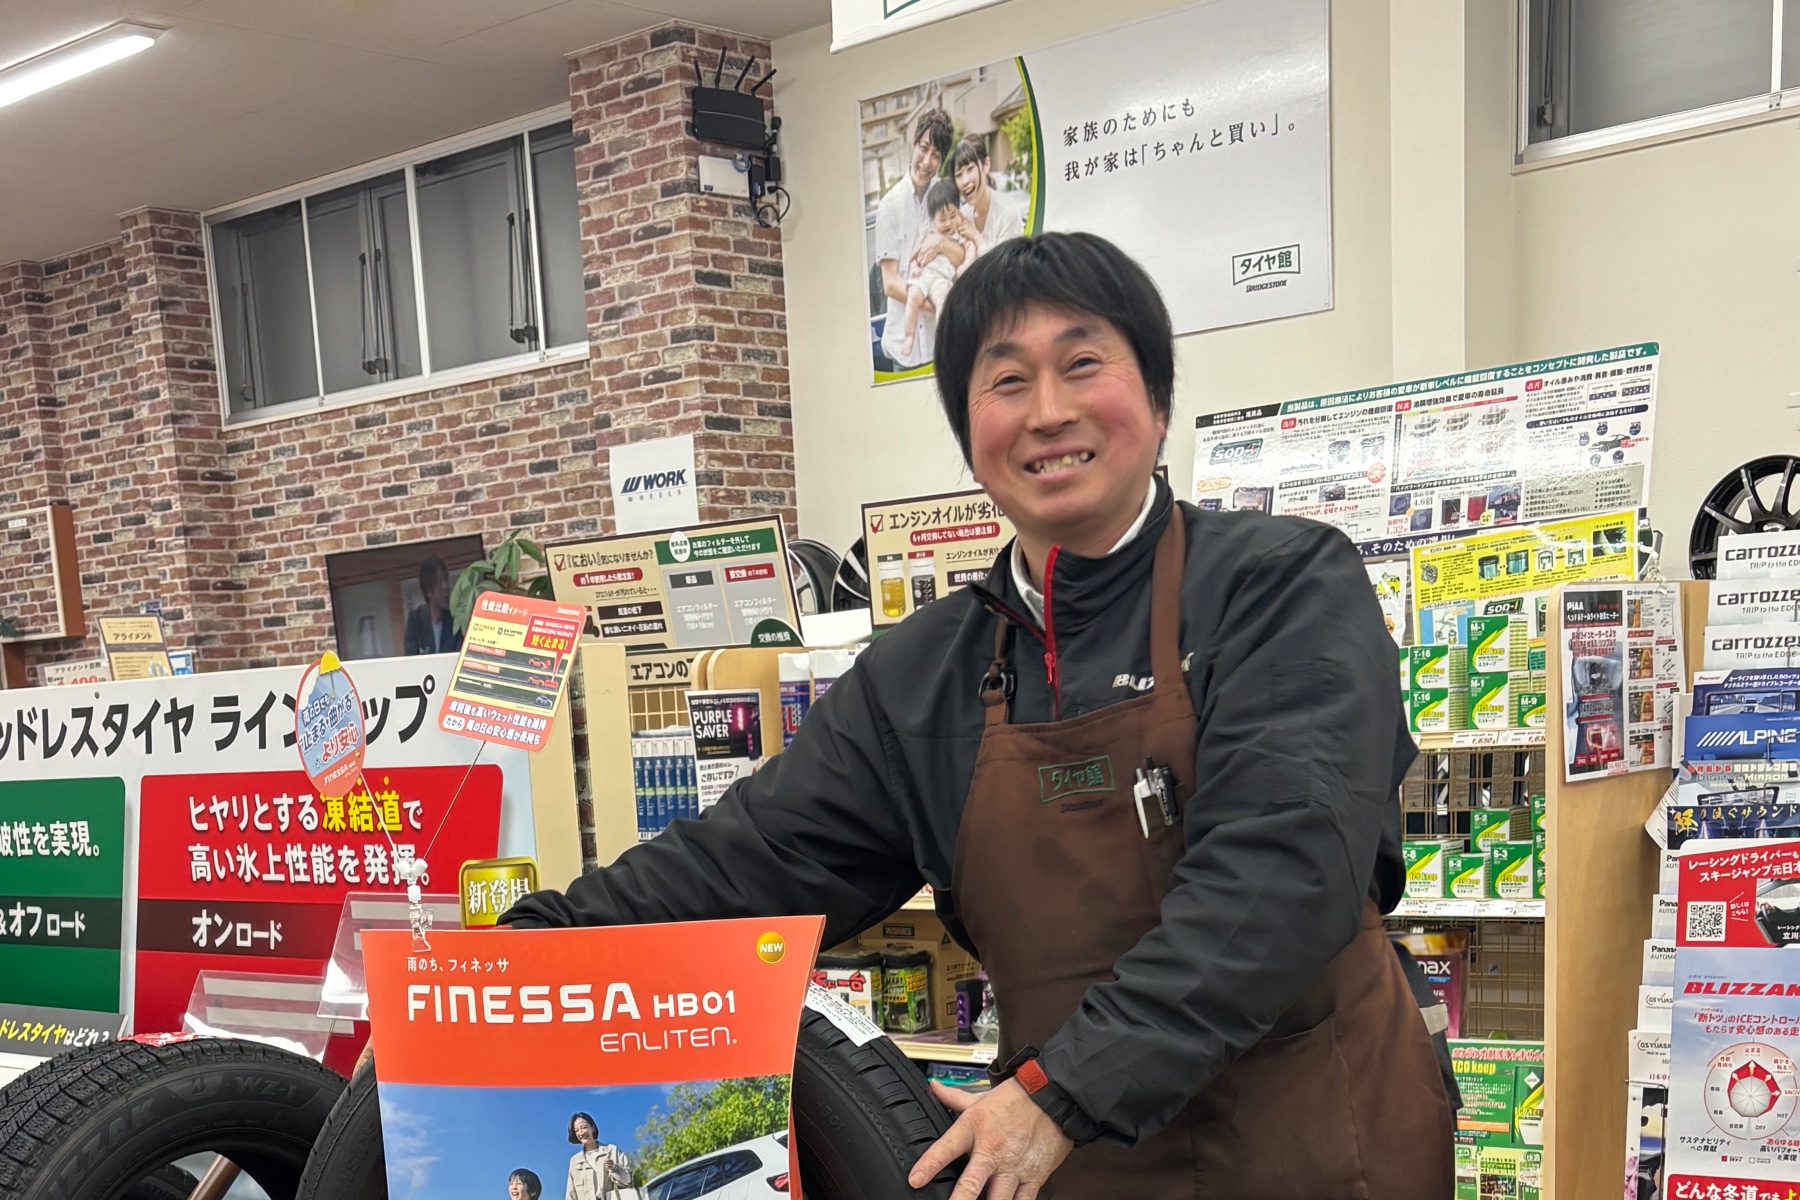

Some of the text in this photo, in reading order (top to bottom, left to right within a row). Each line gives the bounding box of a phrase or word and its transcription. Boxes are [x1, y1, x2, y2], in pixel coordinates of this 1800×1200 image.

[1062, 98, 1195, 148] 家族のためにも
[1063, 113, 1295, 182] 我が家は「ちゃんと買い」。
[1239, 250, 1292, 276] タイヤ館
[643, 468, 687, 491] WORK
[1566, 602, 1584, 611] PIAA
[631, 658, 694, 681] エアコンの
[692, 709, 733, 725] PURPLE
[696, 725, 730, 739] SAVER
[1726, 728, 1798, 747] ALPINE
[188, 792, 423, 833] ヒヤリとする凍結道で
[1688, 850, 1799, 870] レーシングドライバーも
[191, 908, 284, 949] オンロード
[759, 942, 784, 954] NEW
[406, 956, 510, 974] 雨のち、フィネッサ
[406, 981, 737, 1025] FINESSA HB01
[1679, 1136, 1731, 1147] サステナビリティ
